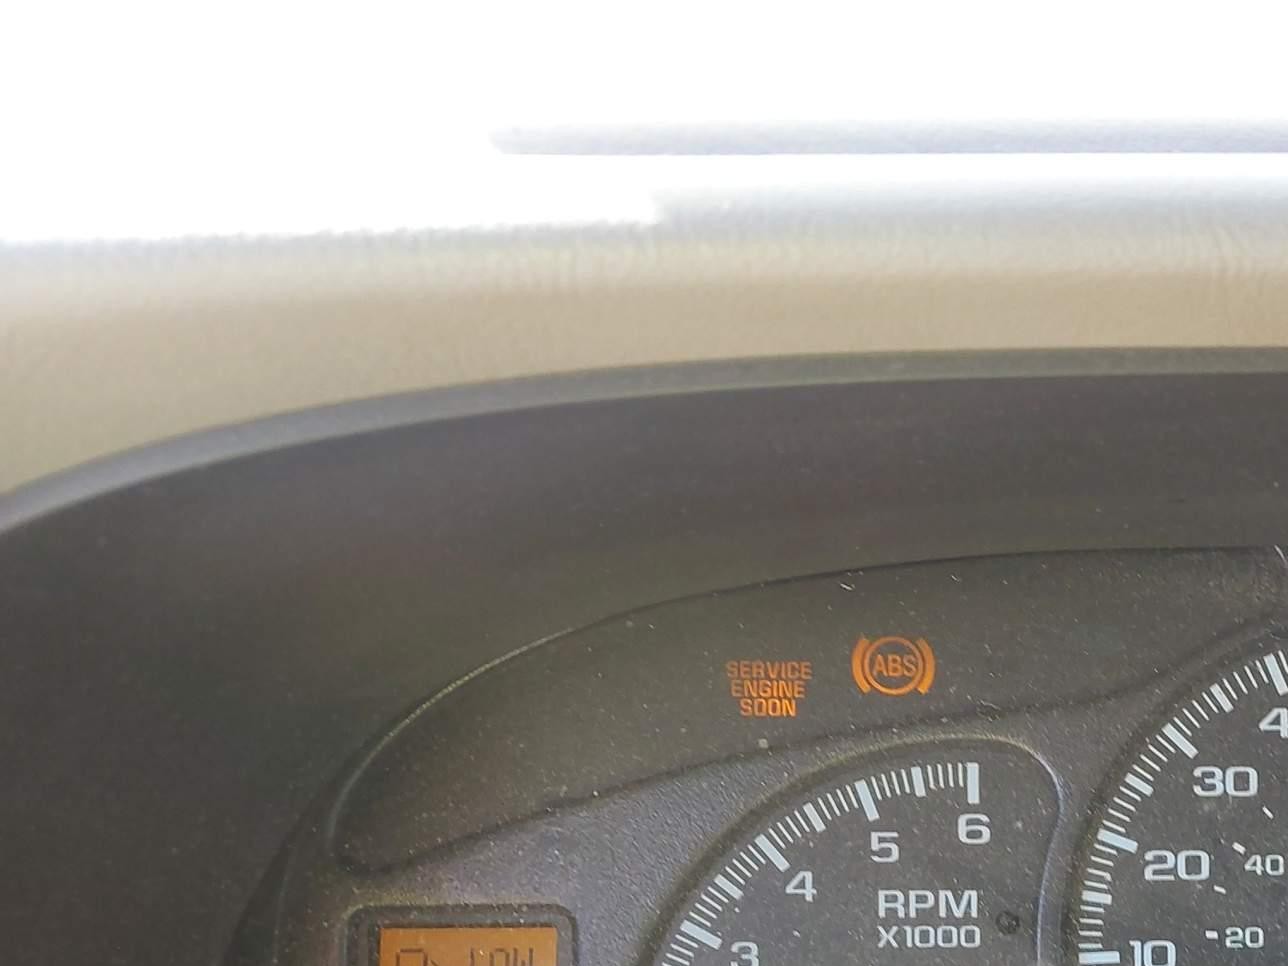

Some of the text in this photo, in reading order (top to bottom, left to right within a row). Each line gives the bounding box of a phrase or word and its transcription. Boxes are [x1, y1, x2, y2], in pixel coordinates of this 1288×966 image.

[726, 661, 812, 678] SERVICE
[872, 655, 917, 677] ABS
[730, 679, 806, 699] ENGINE
[740, 698, 797, 717] SOON
[1192, 766, 1258, 798] 30
[957, 813, 992, 845] 6
[870, 831, 900, 864] 5
[1144, 849, 1210, 882] 20
[1244, 854, 1285, 876] 40
[785, 871, 817, 903] 4
[877, 890, 979, 919] RPM
[877, 925, 981, 950] X1000
[1225, 925, 1265, 948] 20
